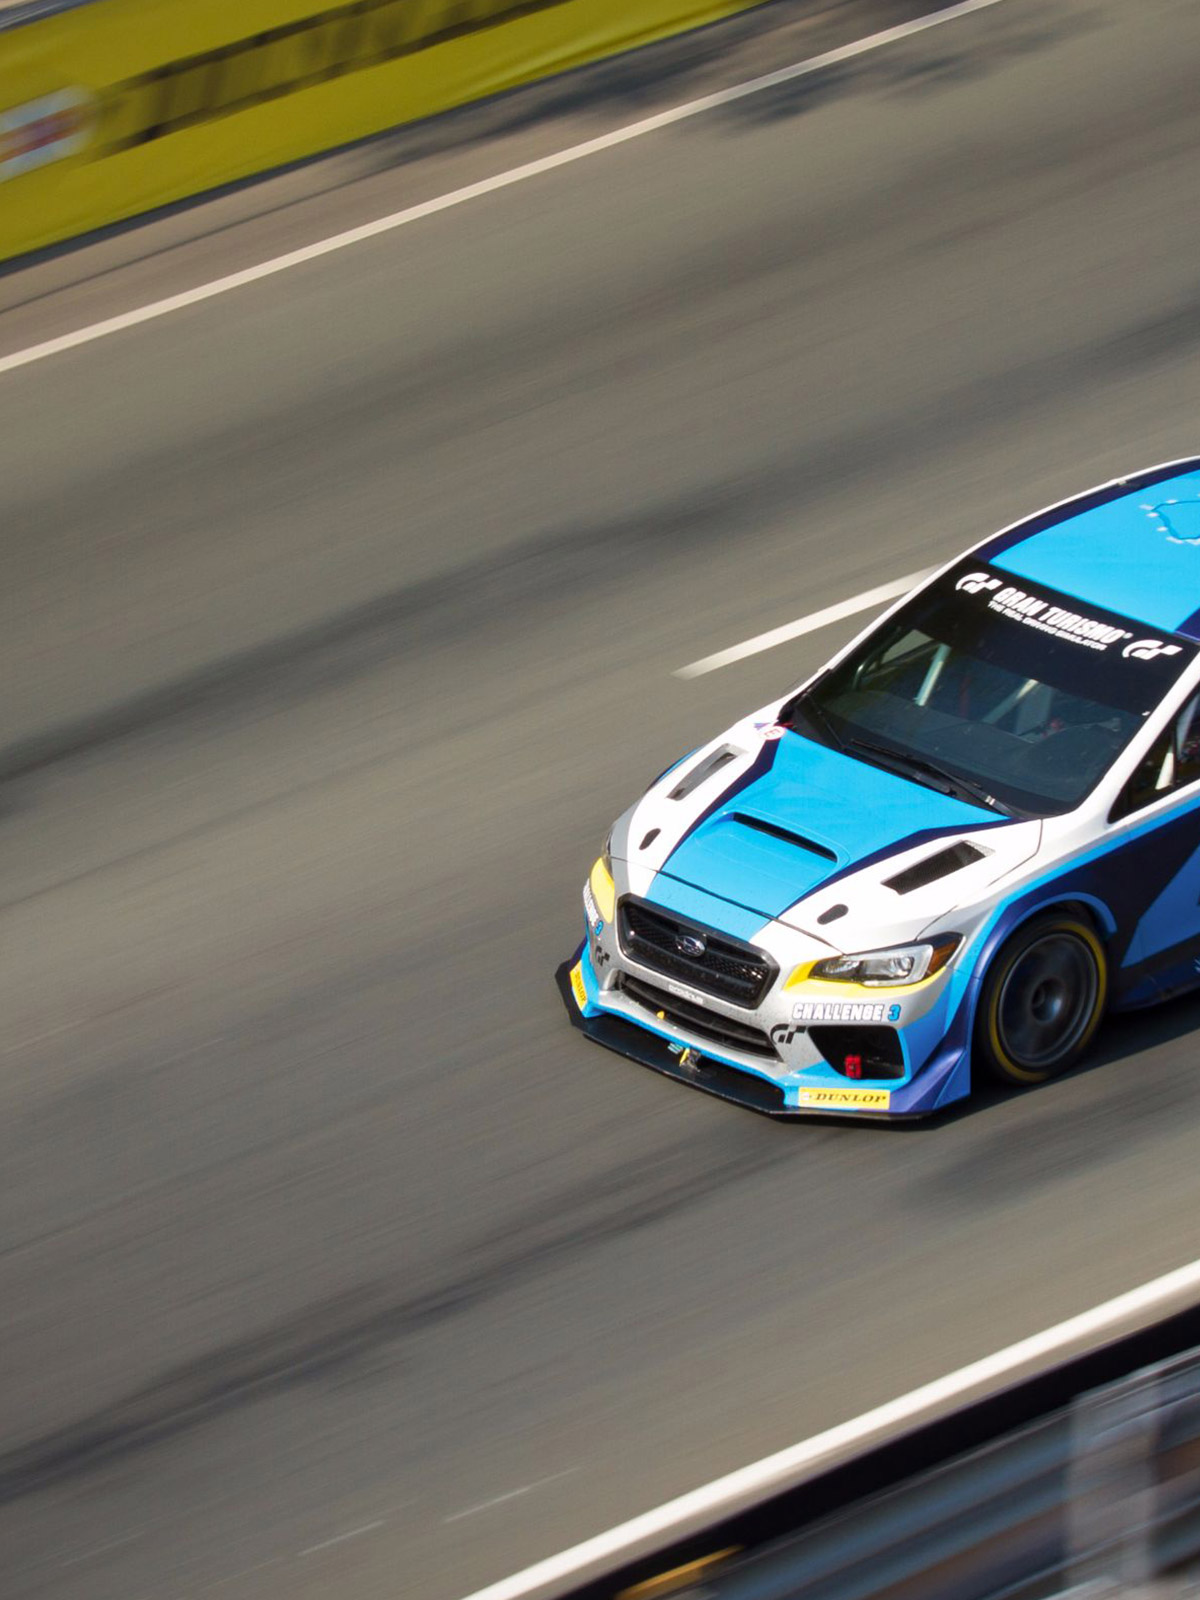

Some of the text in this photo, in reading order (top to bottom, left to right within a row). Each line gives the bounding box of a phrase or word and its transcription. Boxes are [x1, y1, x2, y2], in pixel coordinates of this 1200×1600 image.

[992, 587, 1049, 618] GRAN
[1038, 606, 1126, 644] TURISMO
[792, 1003, 901, 1021] CHALLENGE 3
[815, 1093, 886, 1103] DUNLOP
